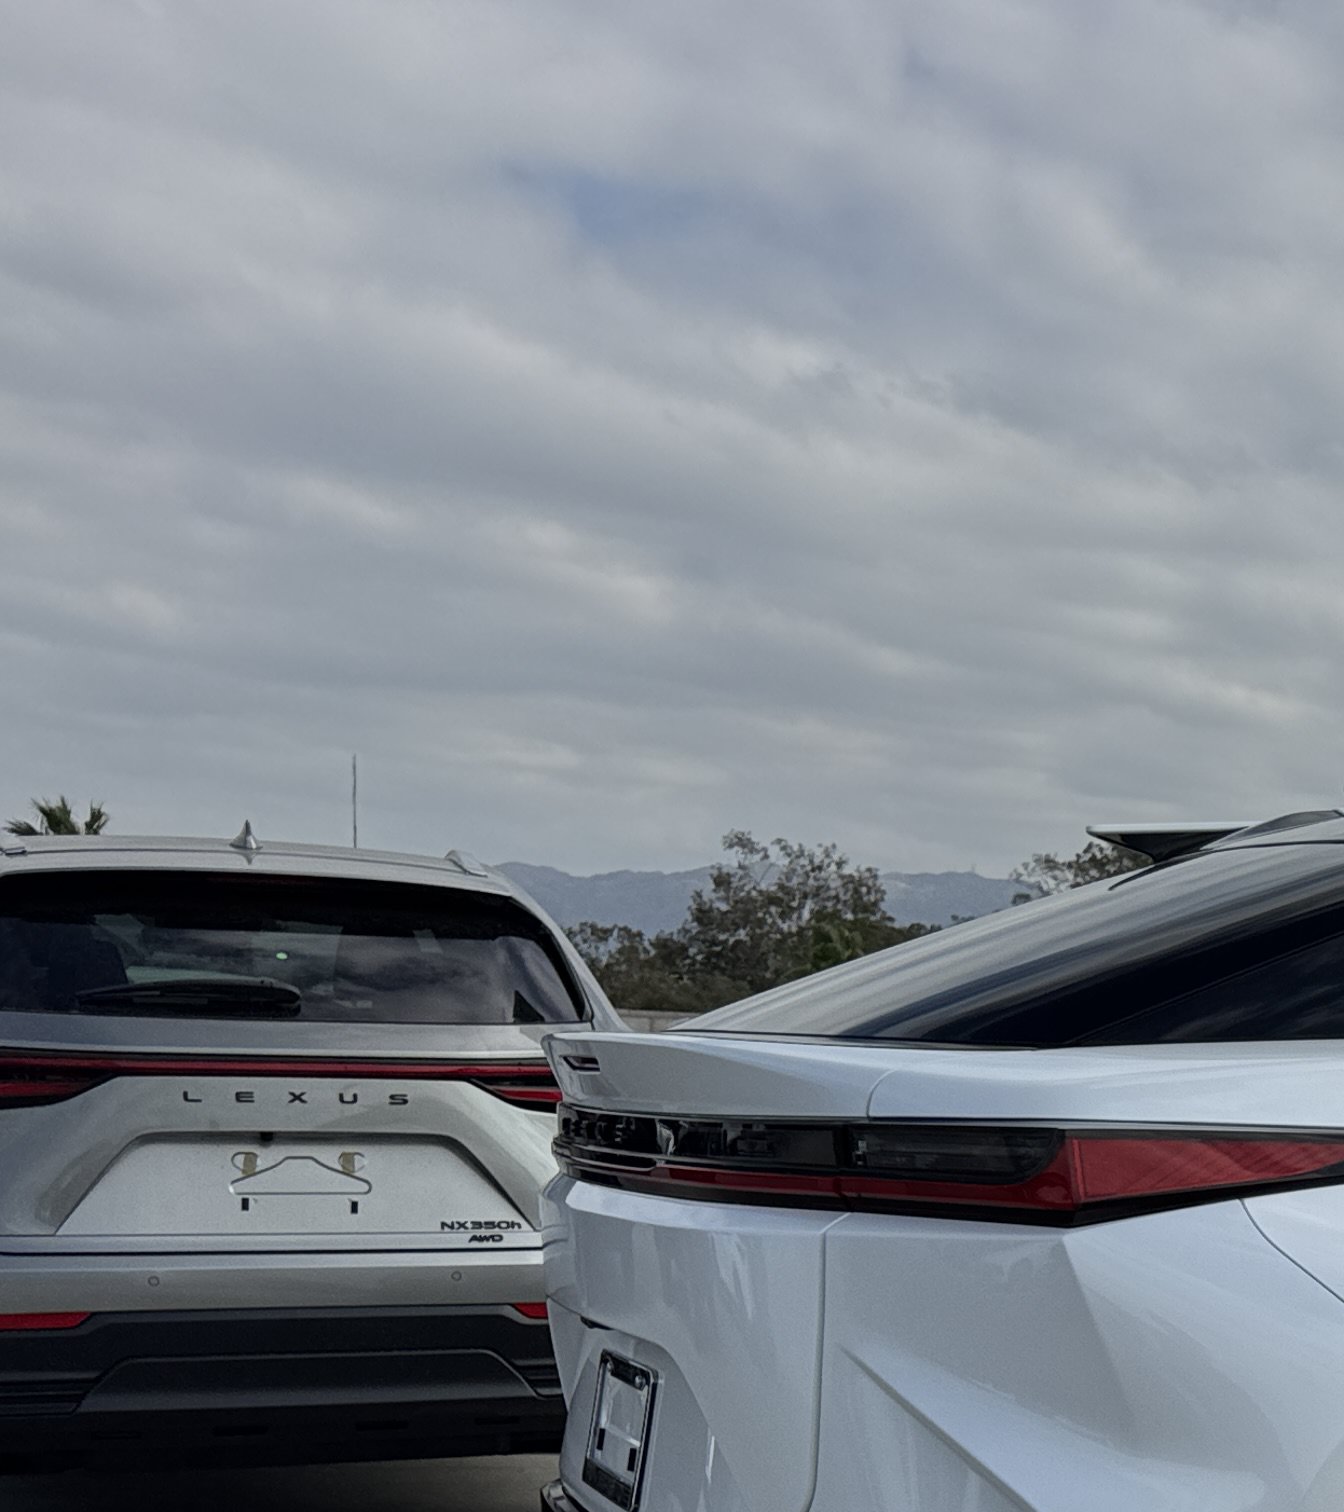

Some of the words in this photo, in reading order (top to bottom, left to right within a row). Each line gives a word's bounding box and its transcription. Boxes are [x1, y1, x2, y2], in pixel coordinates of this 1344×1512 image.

[183, 1090, 409, 1106] LEXUS
[441, 1220, 522, 1231] NX350h
[468, 1234, 504, 1244] AWD
